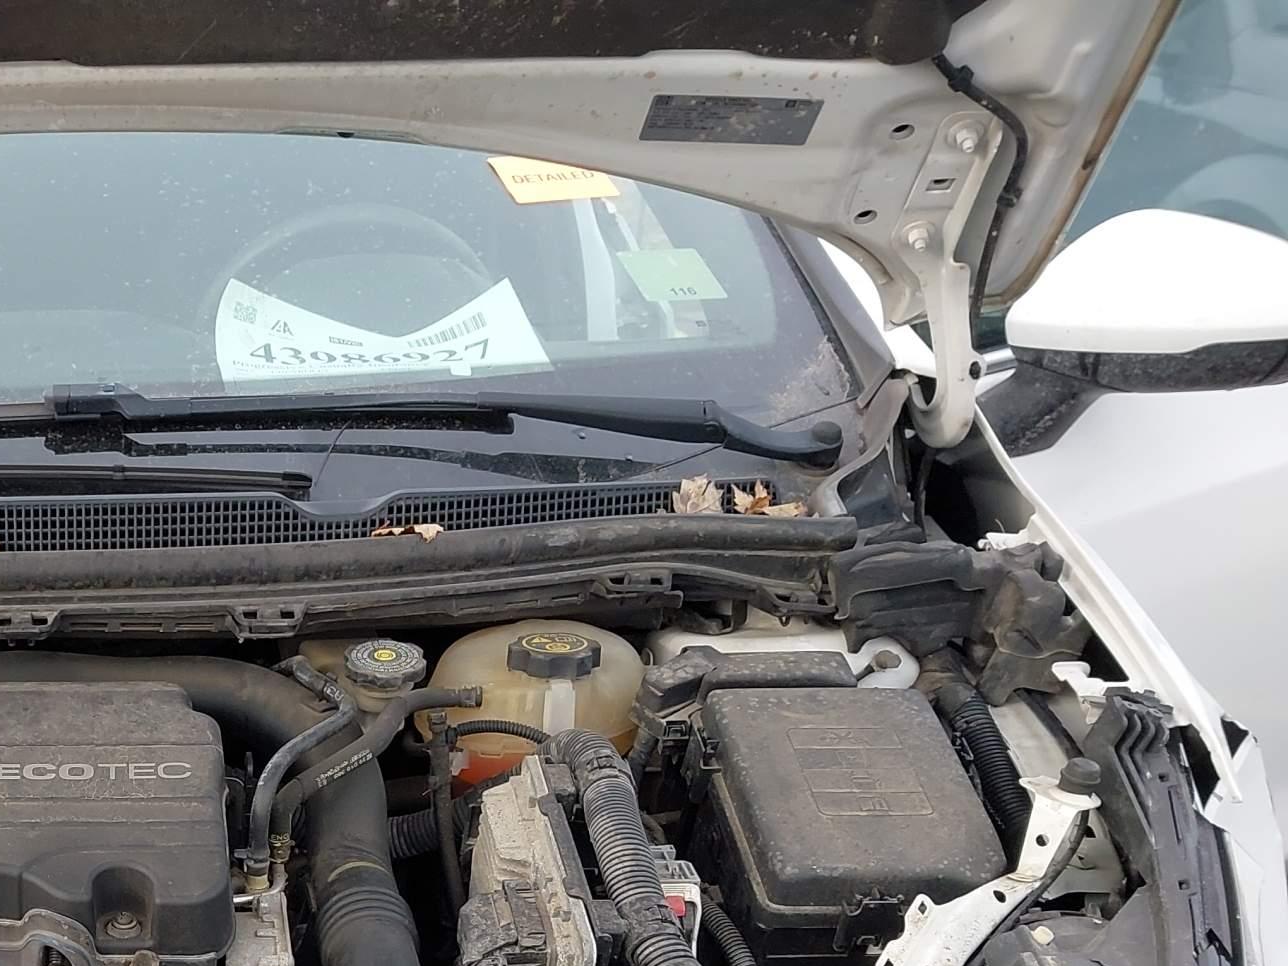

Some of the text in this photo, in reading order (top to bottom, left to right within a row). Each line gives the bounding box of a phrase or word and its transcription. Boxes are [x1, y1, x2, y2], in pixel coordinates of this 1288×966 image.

[511, 169, 596, 185] DETAILED
[669, 286, 697, 296] 116
[249, 337, 489, 366] 43986927
